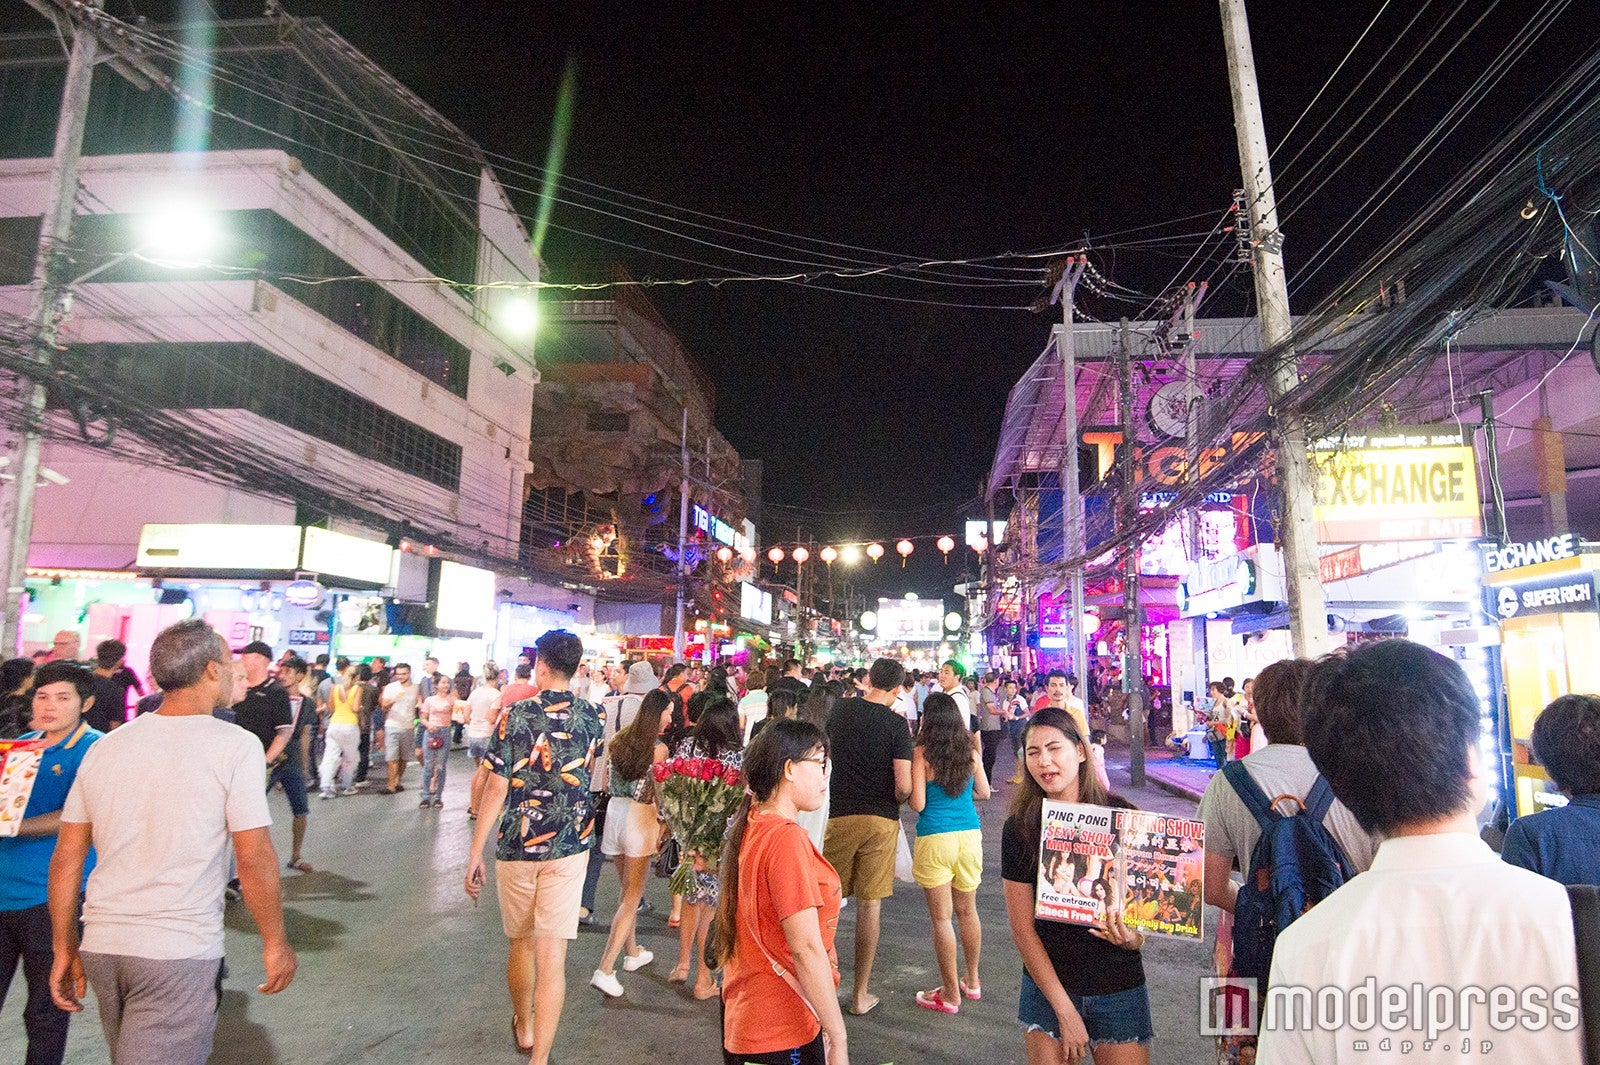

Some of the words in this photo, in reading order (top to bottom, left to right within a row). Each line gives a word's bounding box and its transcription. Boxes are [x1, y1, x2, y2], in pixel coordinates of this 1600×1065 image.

[1429, 517, 1473, 536] RATE
[1485, 533, 1575, 572] EXCHANGE
[1522, 587, 1561, 608] SUPER
[1560, 583, 1591, 604] RICH
[1047, 810, 1074, 823] PING
[1077, 814, 1108, 827] PONG
[1046, 825, 1077, 840] SEXY
[1079, 829, 1116, 846] SHOW
[1167, 818, 1204, 840] SHOW
[1046, 839, 1072, 853] MAN
[1073, 842, 1109, 858] SHOW
[1041, 892, 1059, 902] Free
[1062, 896, 1097, 908] entrance
[1071, 909, 1093, 923] Free
[1175, 923, 1198, 935] Drink
